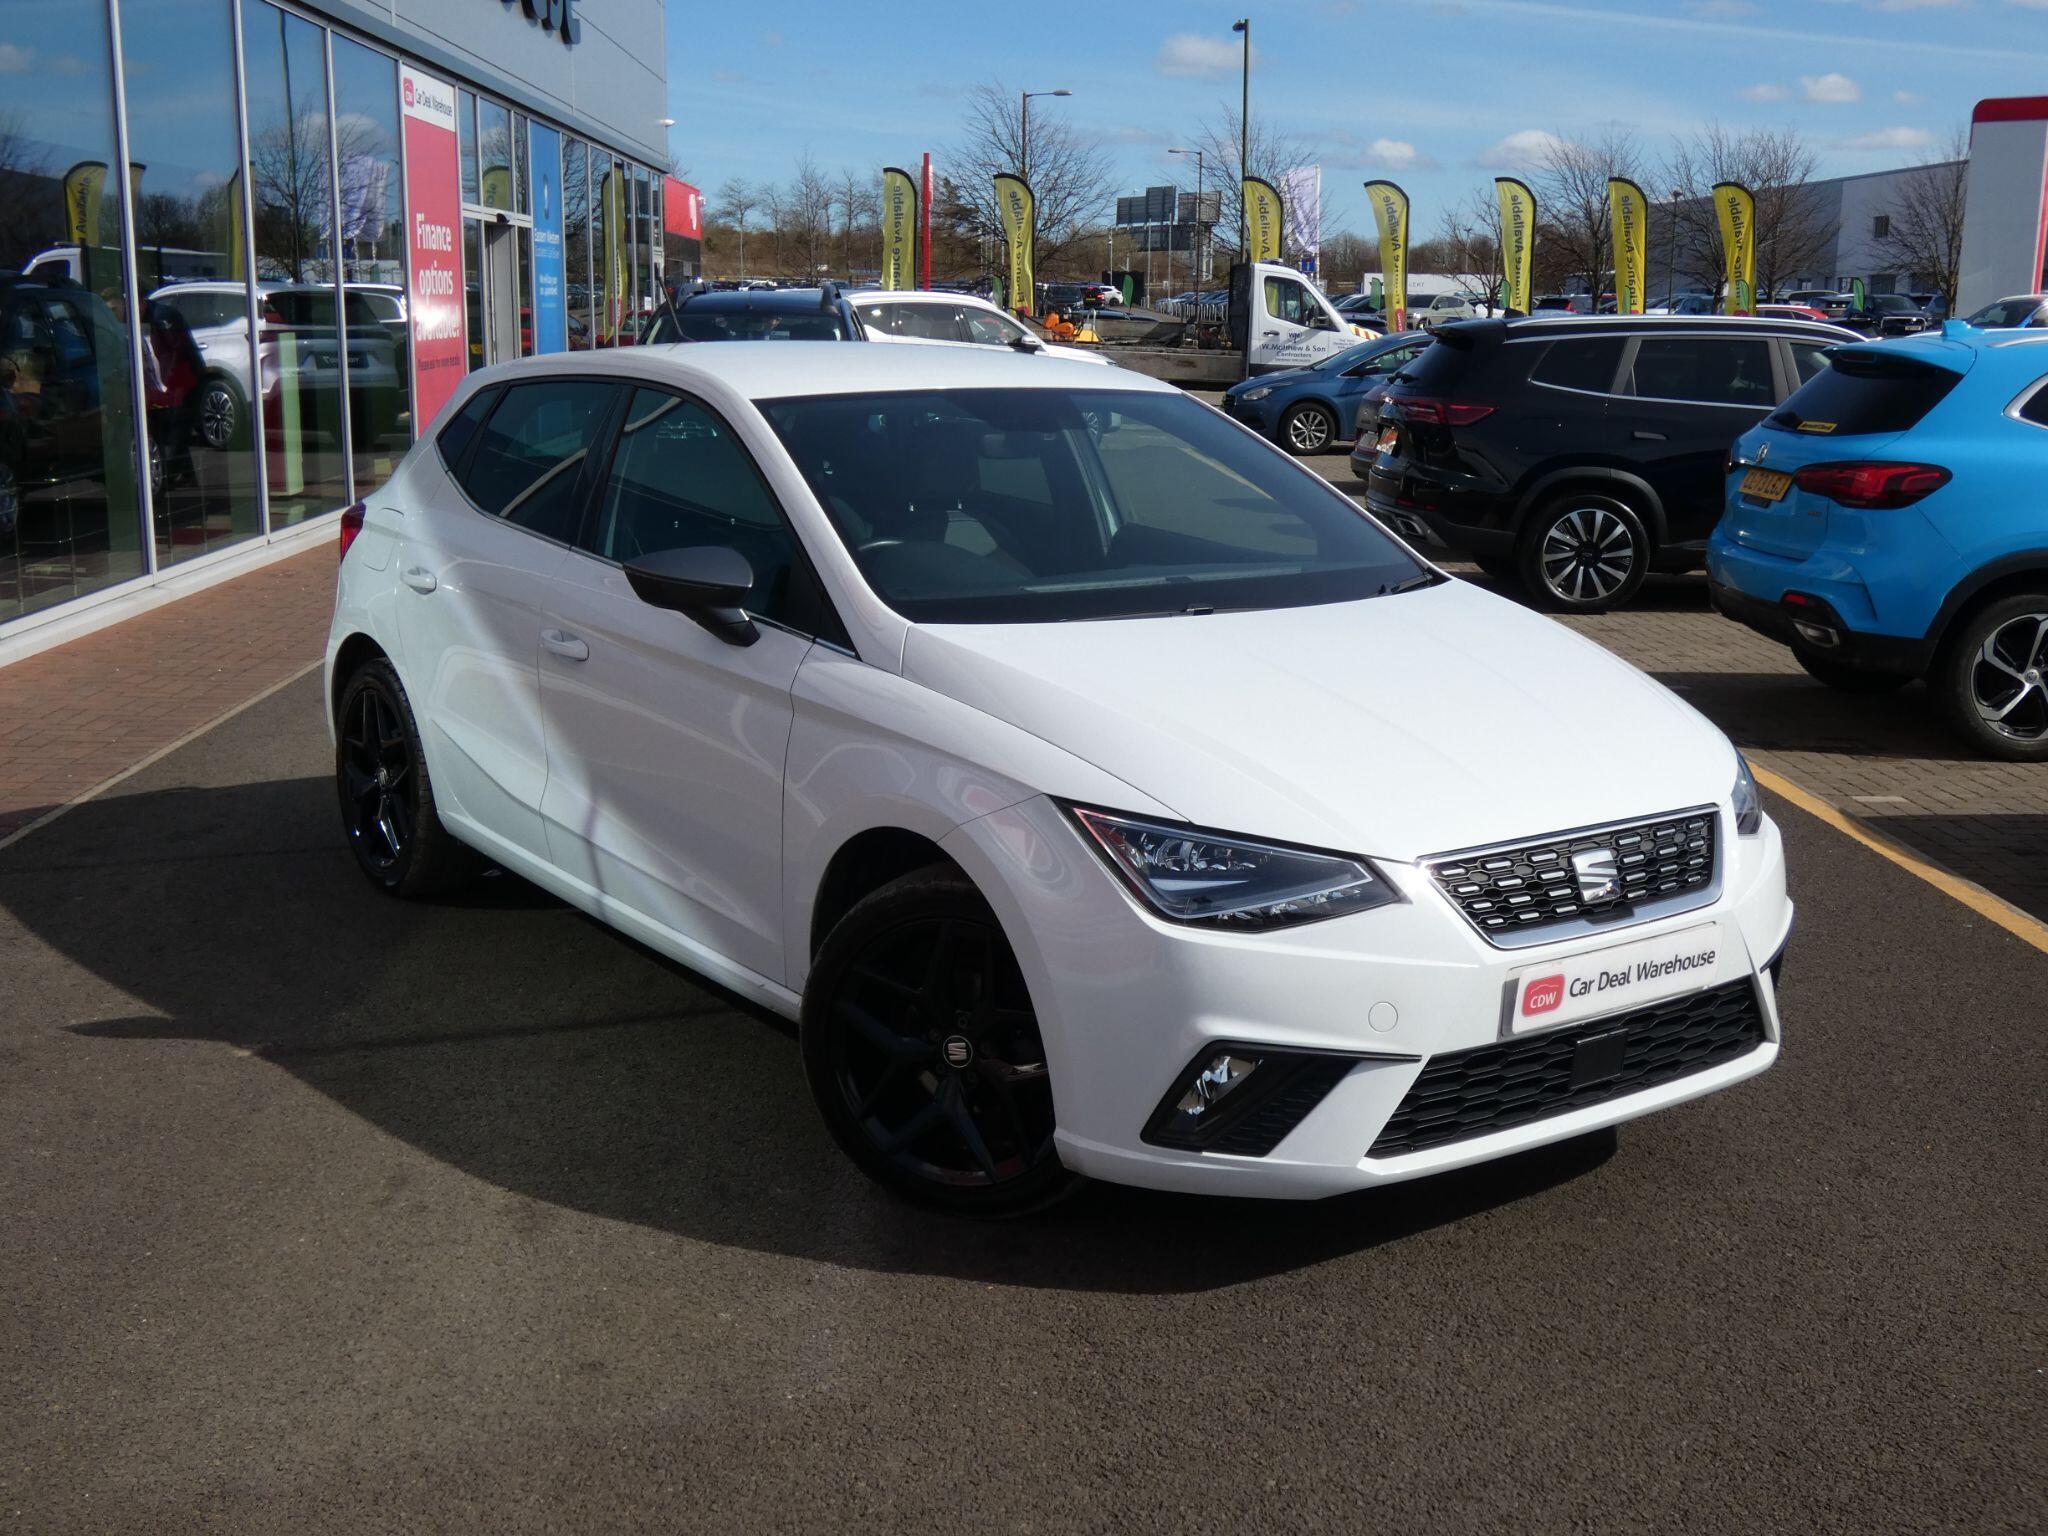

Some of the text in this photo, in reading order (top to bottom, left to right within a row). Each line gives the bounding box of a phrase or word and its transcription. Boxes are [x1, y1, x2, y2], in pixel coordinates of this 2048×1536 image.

[416, 213, 452, 251] Finance
[419, 260, 453, 305] options
[1569, 950, 1716, 998] Car Deal Warehouse
[1530, 992, 1557, 1009] CDW
